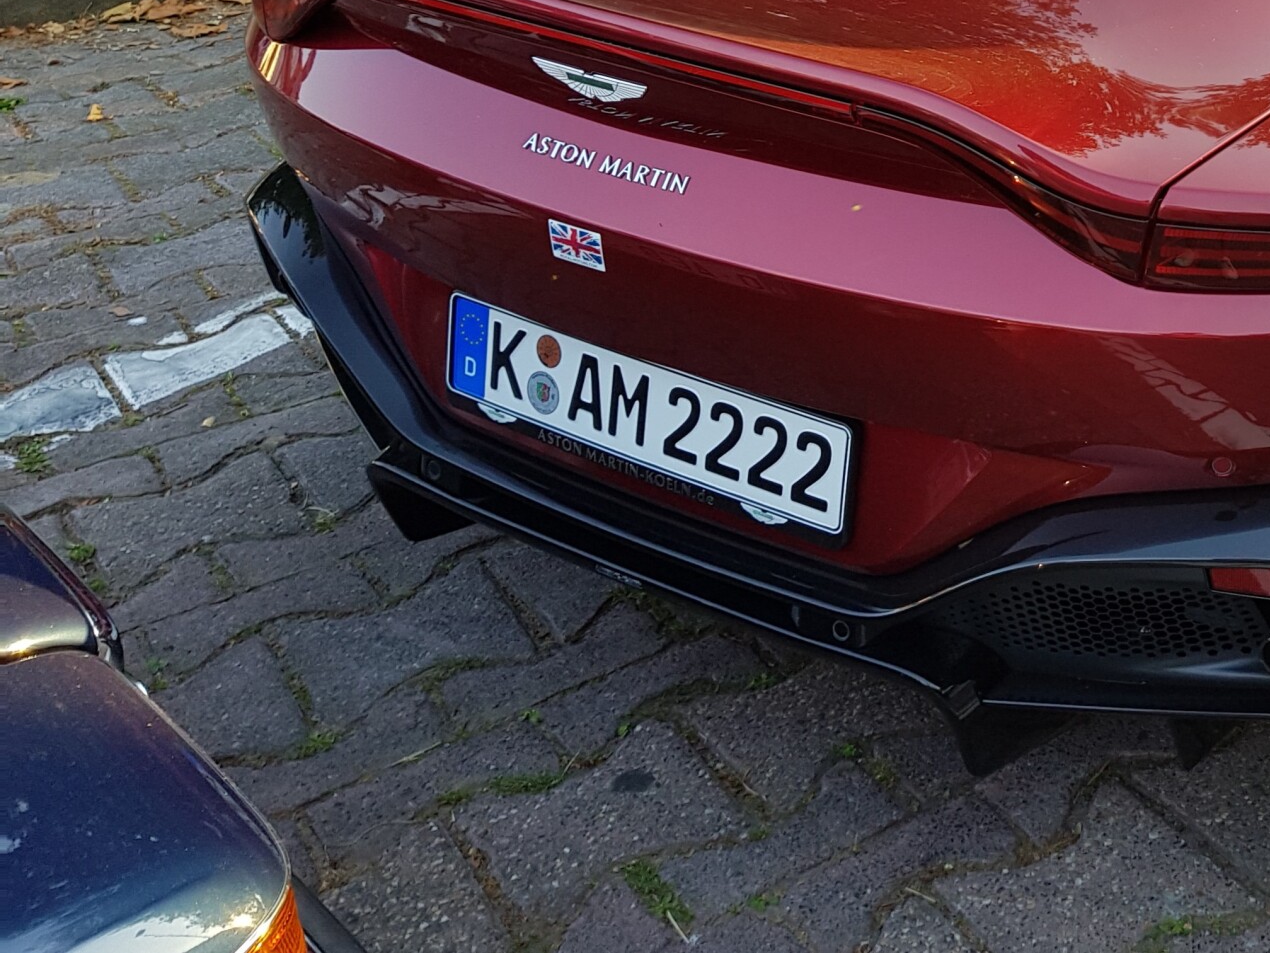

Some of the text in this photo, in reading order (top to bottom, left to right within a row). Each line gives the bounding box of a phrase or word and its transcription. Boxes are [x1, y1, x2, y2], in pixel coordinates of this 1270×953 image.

[522, 132, 691, 195] ASTON MARTIN
[464, 356, 477, 377] D
[490, 321, 527, 400] K
[567, 353, 650, 447] AM
[662, 386, 832, 513] 2222
[537, 429, 715, 506] ASTON MARTIN-KOELN.de
